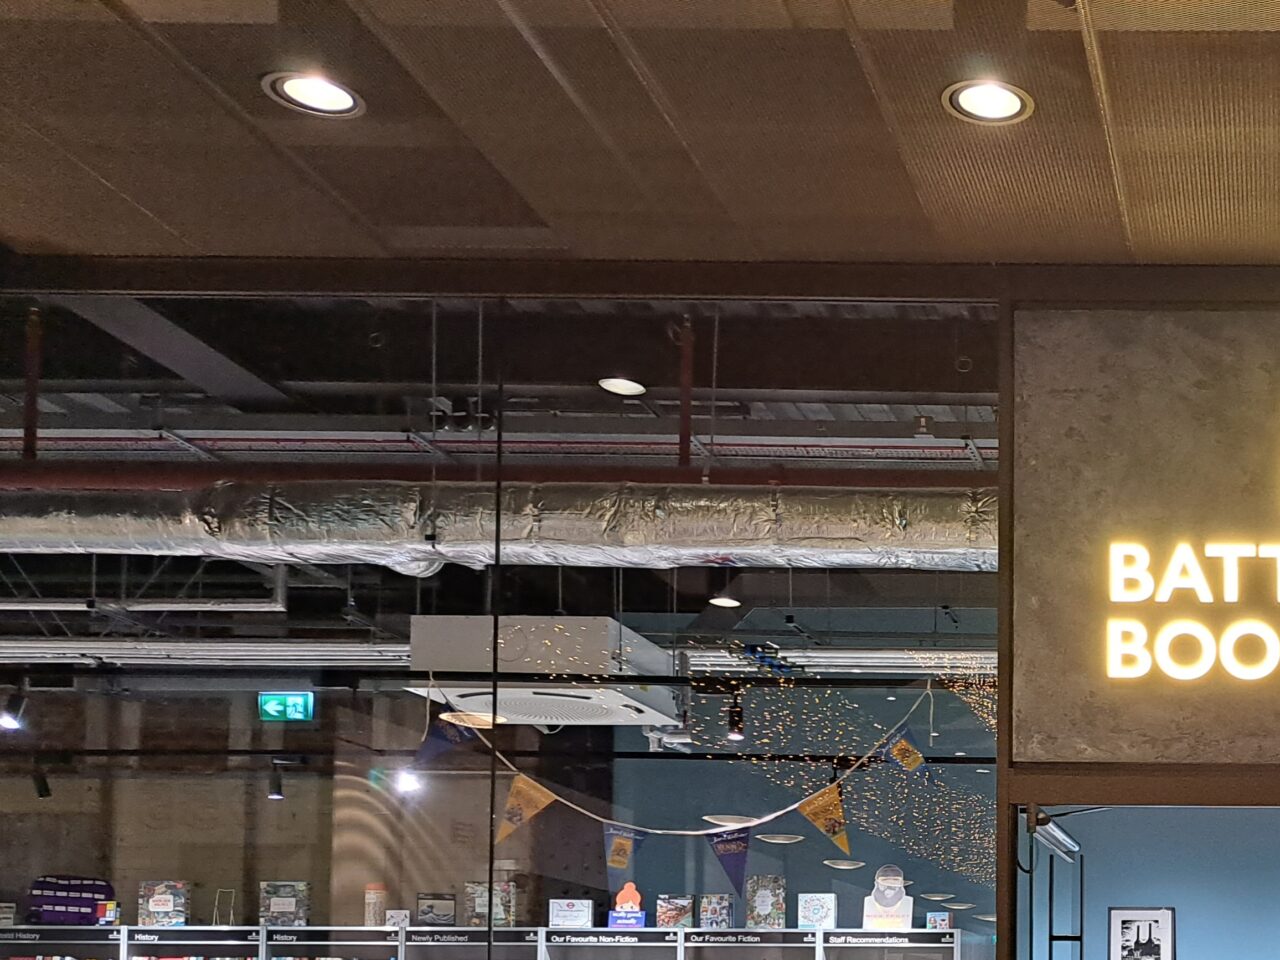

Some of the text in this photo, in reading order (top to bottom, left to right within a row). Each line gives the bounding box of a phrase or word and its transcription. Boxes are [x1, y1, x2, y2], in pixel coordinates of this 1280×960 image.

[15, 932, 41, 941] History
[134, 934, 159, 942] History
[272, 934, 297, 942] History
[412, 934, 468, 942] Newly Published
[847, 936, 908, 944] Recommendations
